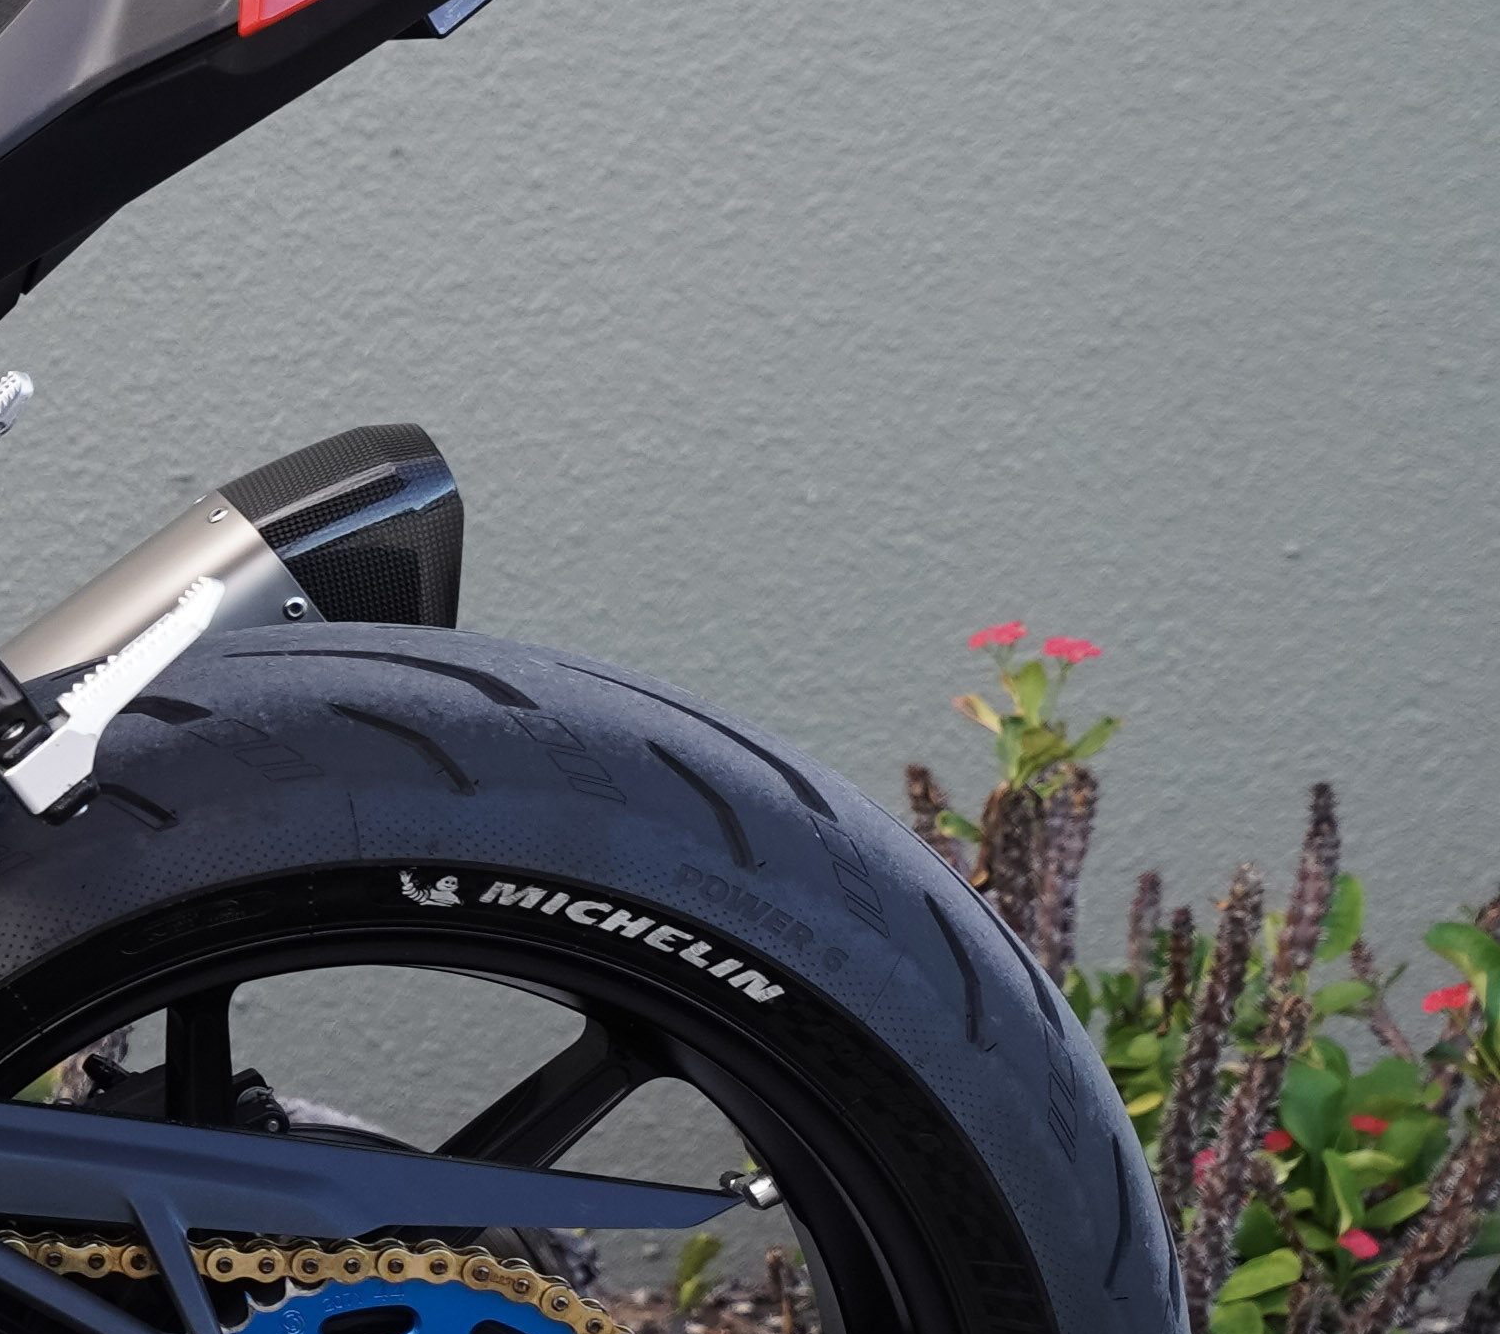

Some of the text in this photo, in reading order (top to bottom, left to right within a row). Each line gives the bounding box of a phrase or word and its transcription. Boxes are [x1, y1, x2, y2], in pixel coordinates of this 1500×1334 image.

[479, 881, 785, 1003] MICHELIN
[672, 862, 850, 974] POWER 6
